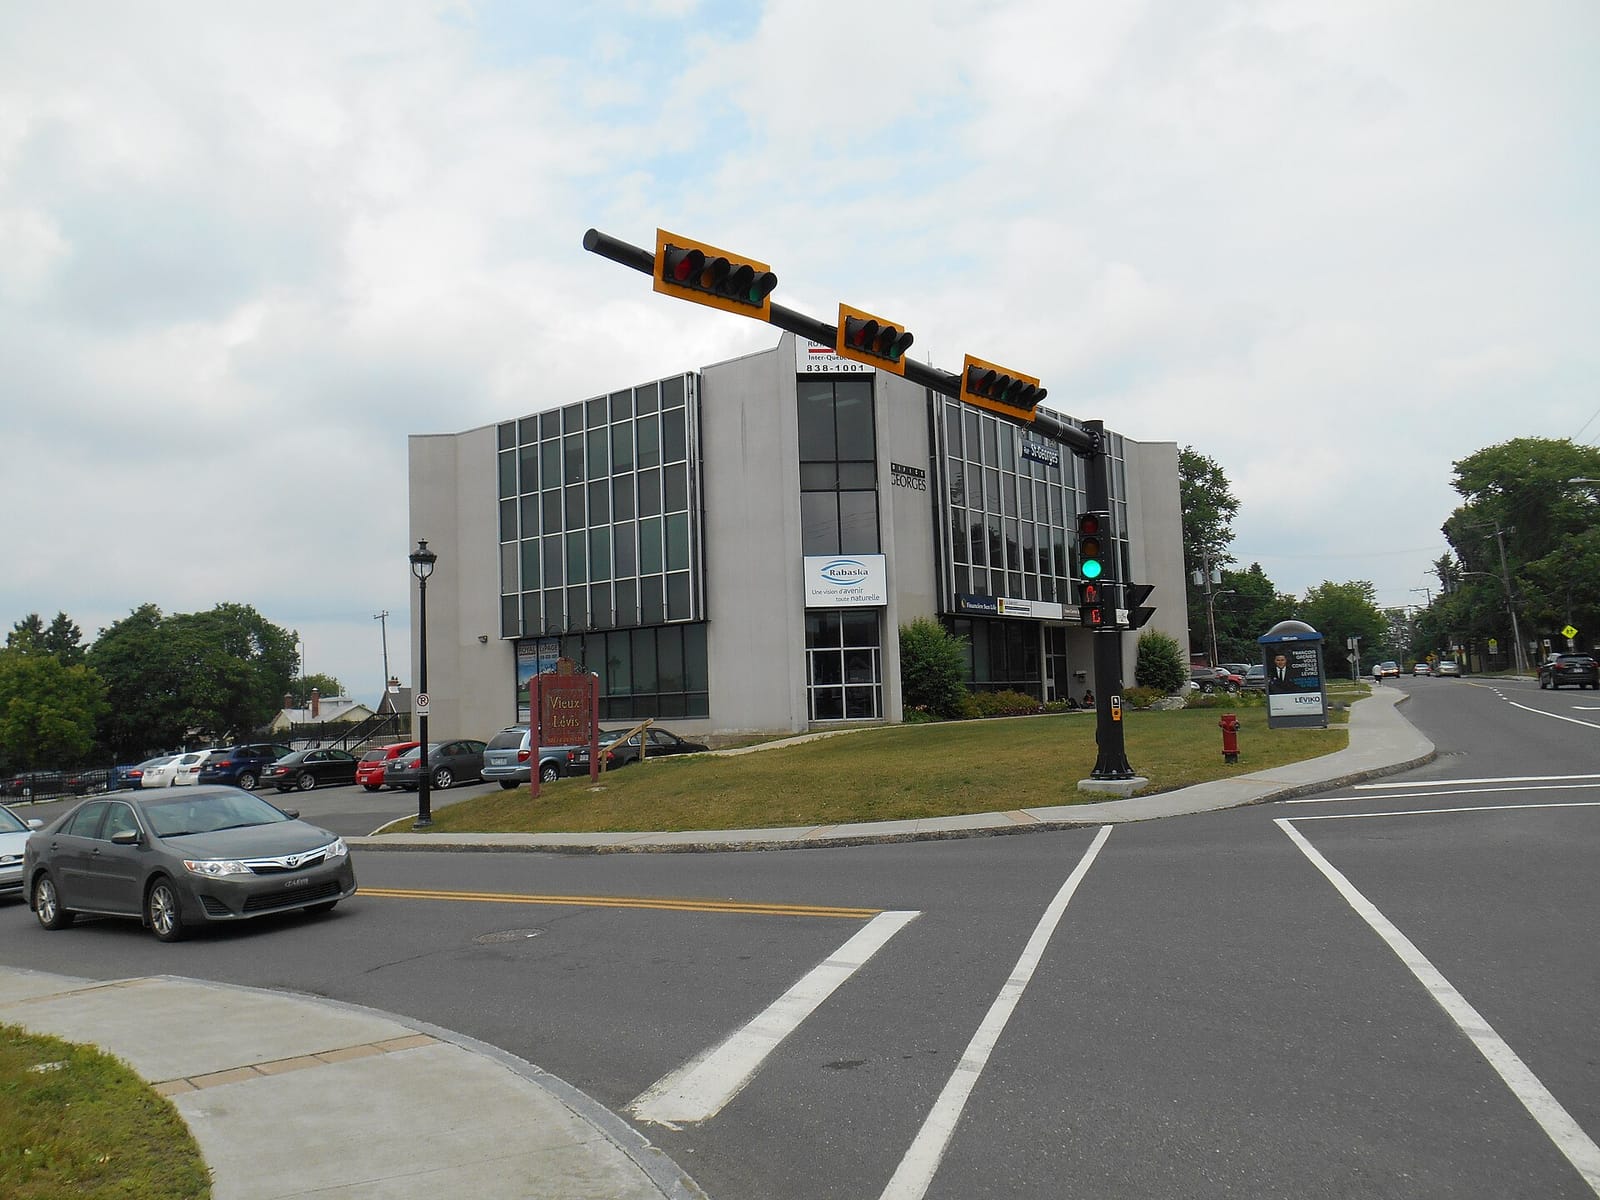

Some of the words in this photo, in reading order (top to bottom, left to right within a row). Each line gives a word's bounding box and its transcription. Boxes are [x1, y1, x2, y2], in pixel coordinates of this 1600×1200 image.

[806, 364, 864, 372] 838-1001
[829, 568, 869, 576] Rabaska
[550, 696, 580, 709] Vieux
[552, 714, 579, 728] Lévis
